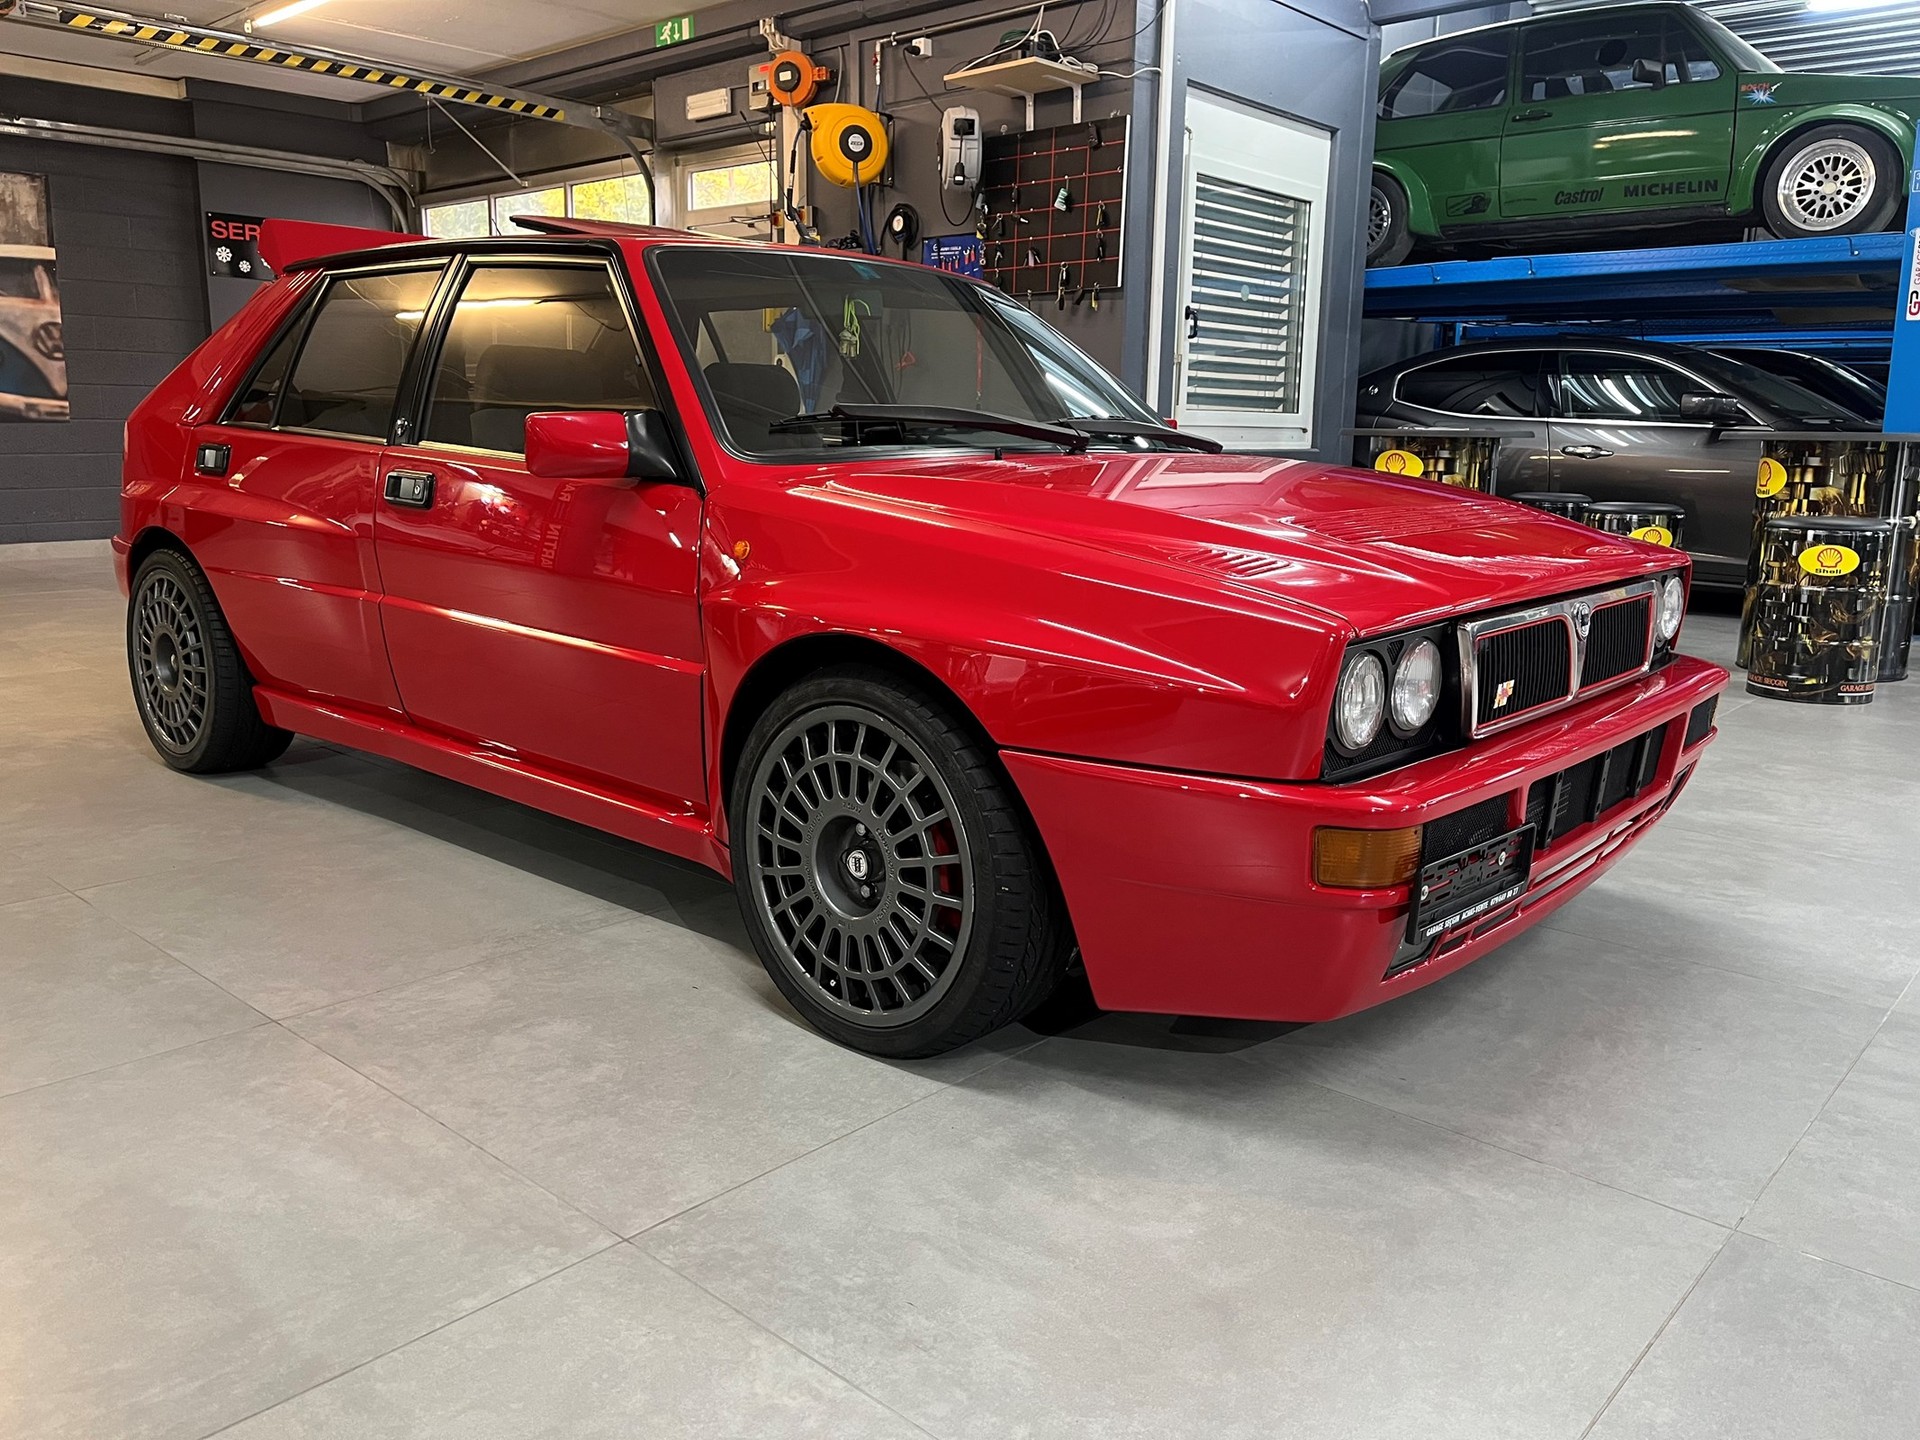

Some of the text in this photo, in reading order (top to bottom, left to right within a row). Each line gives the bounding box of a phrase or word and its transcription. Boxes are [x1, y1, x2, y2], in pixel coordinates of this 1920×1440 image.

[1554, 187, 1604, 206] Castrol
[1624, 179, 1719, 198] MICHELIN
[211, 220, 260, 241] SER
[1814, 567, 1842, 575] Shell
[1840, 684, 1865, 692] GARAGE
[1426, 922, 1444, 937] GARAGE
